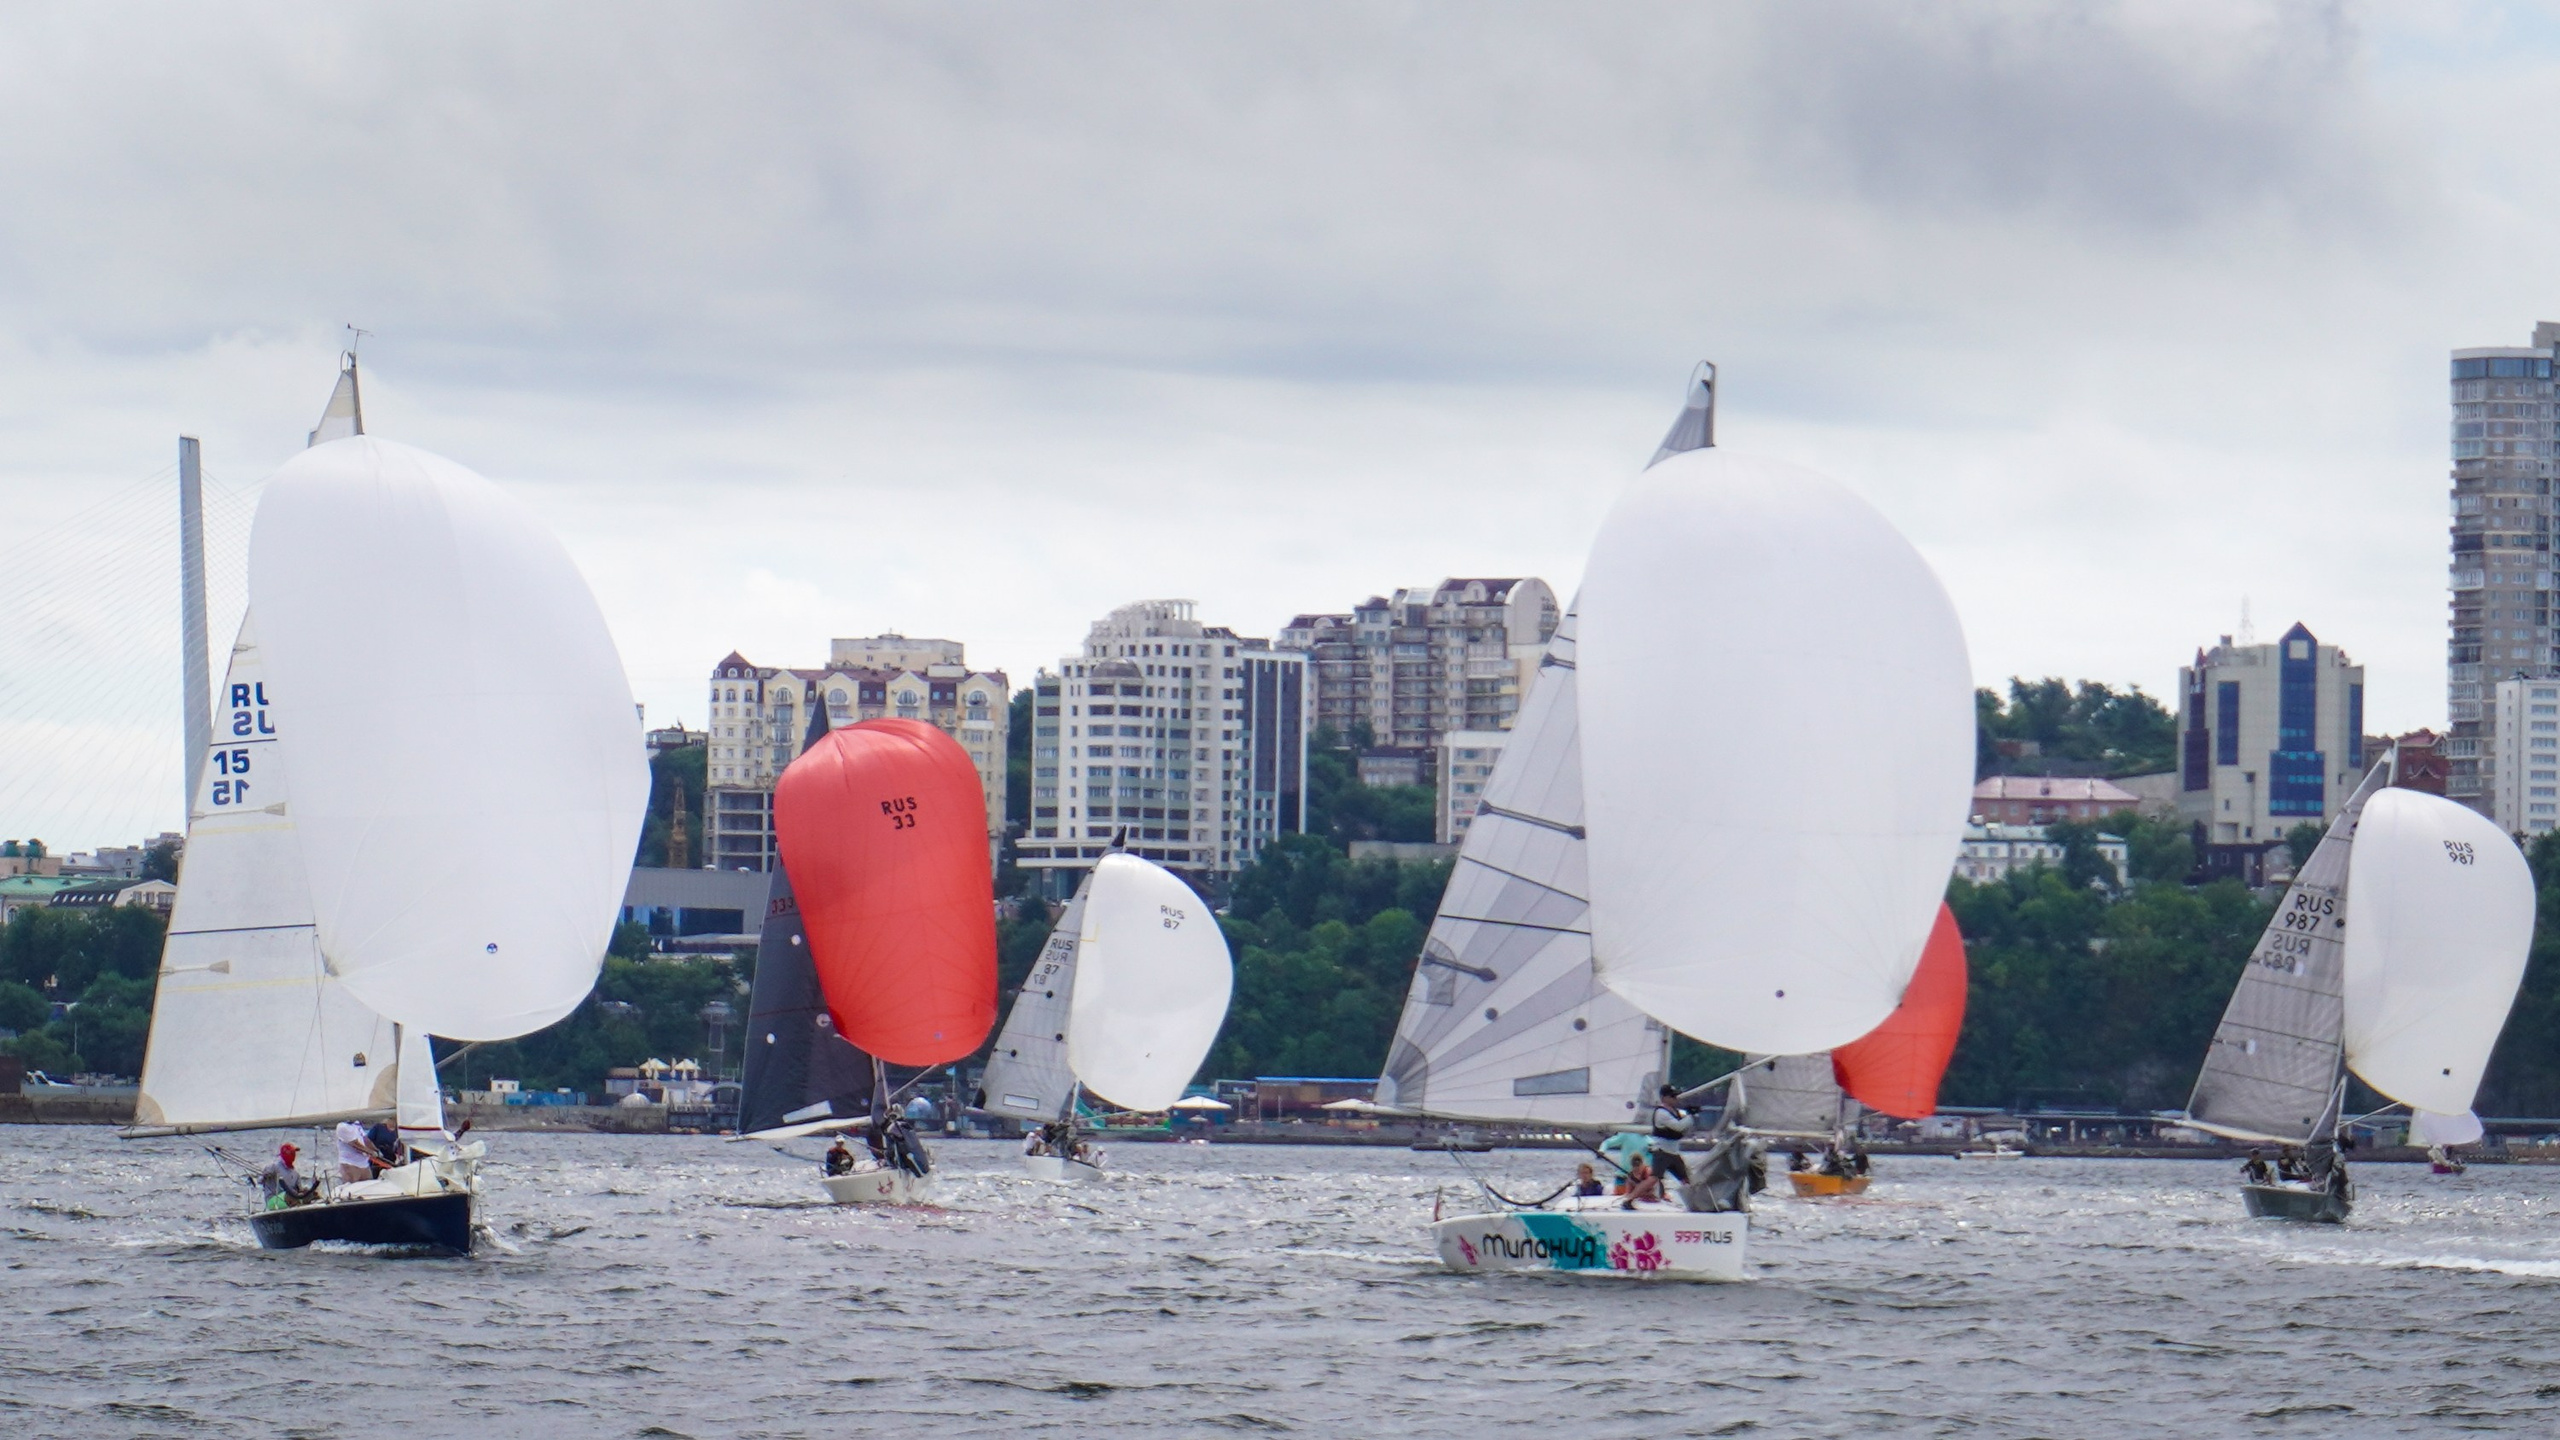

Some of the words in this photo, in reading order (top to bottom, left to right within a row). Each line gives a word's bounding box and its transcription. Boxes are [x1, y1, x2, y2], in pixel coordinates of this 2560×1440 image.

[213, 749, 250, 775] 15
[881, 797, 917, 815] RUS
[893, 814, 916, 830] 33
[2443, 840, 2473, 854] RUS
[2449, 852, 2475, 866] 987
[1160, 904, 1185, 920] RUS
[2295, 894, 2334, 915] RUS
[1163, 918, 1180, 930] 87
[2285, 912, 2320, 932] 987
[1050, 938, 1074, 951] RUS
[1043, 963, 1060, 975] 87
